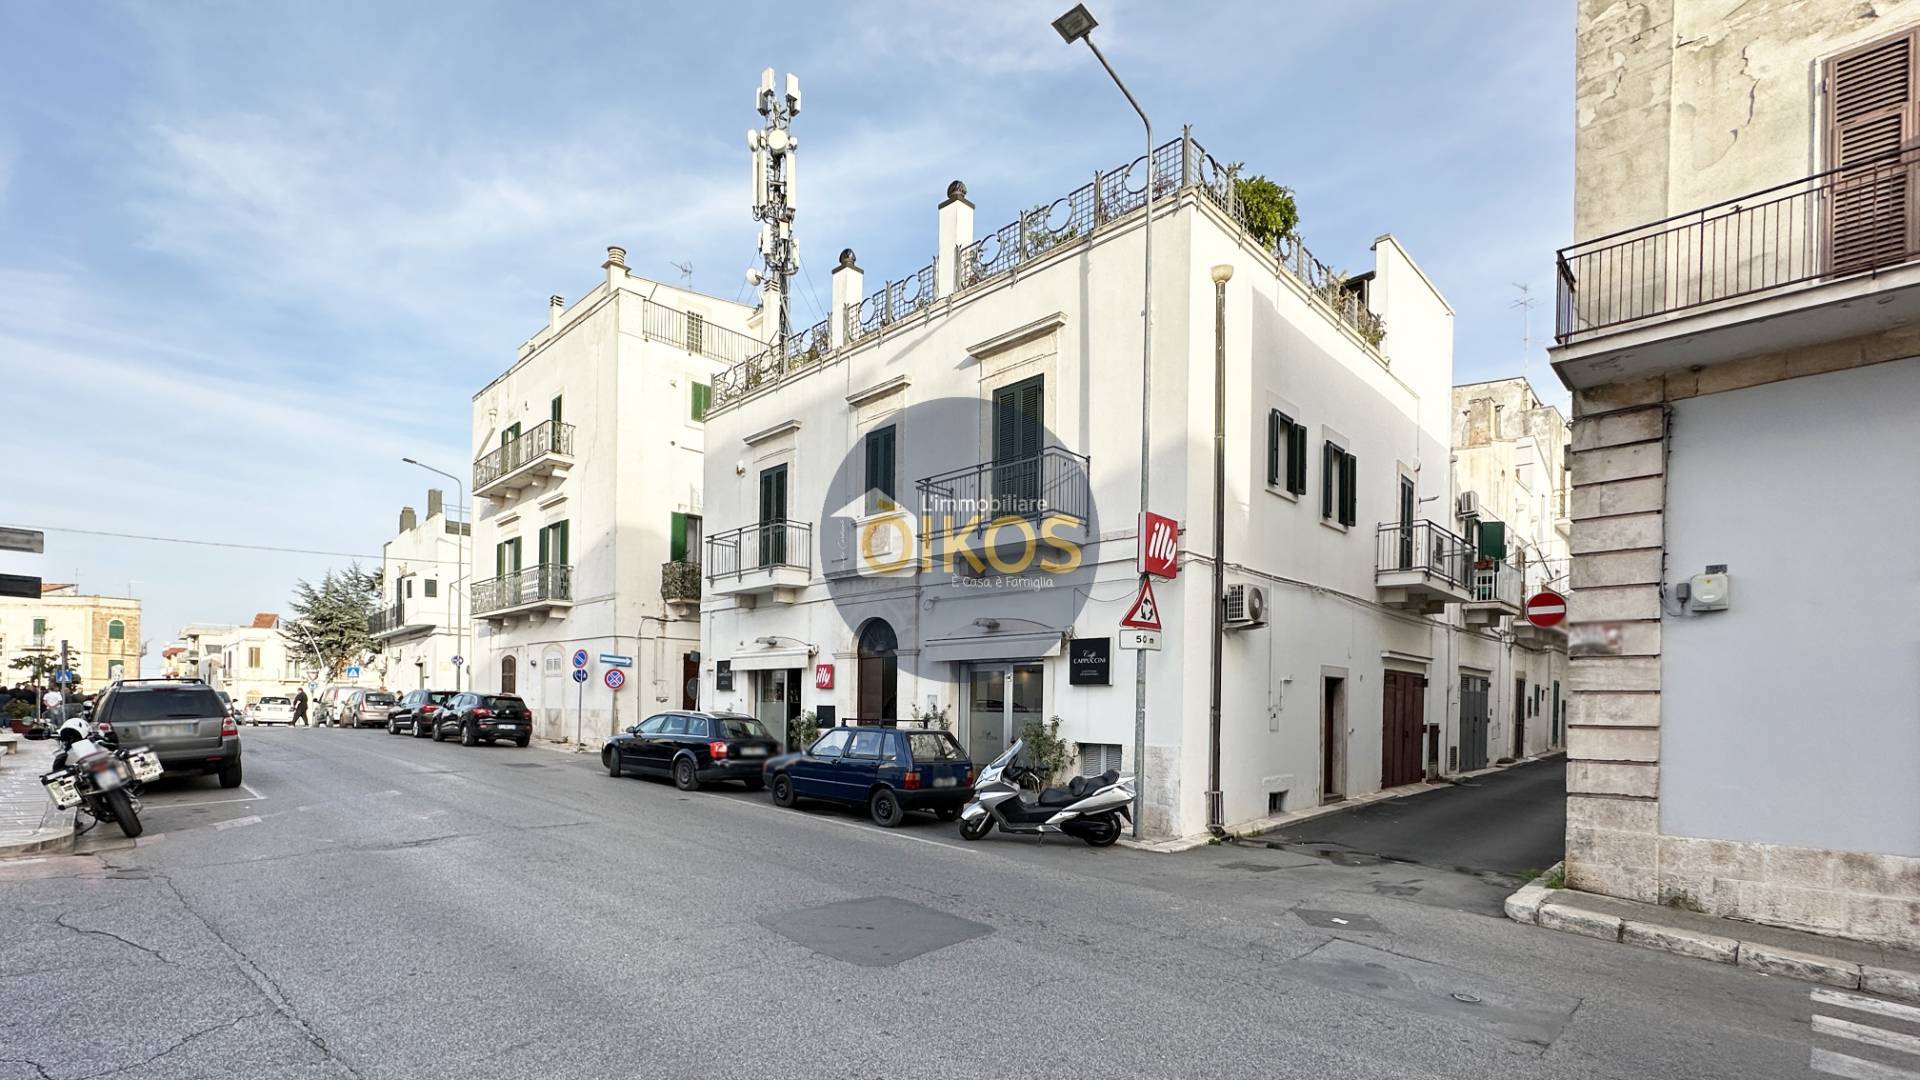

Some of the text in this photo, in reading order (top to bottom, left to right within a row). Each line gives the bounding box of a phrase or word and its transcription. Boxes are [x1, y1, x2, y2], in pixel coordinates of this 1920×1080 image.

[1149, 522, 1176, 569] illy
[1136, 635, 1148, 645] 50
[816, 667, 831, 687] illy
